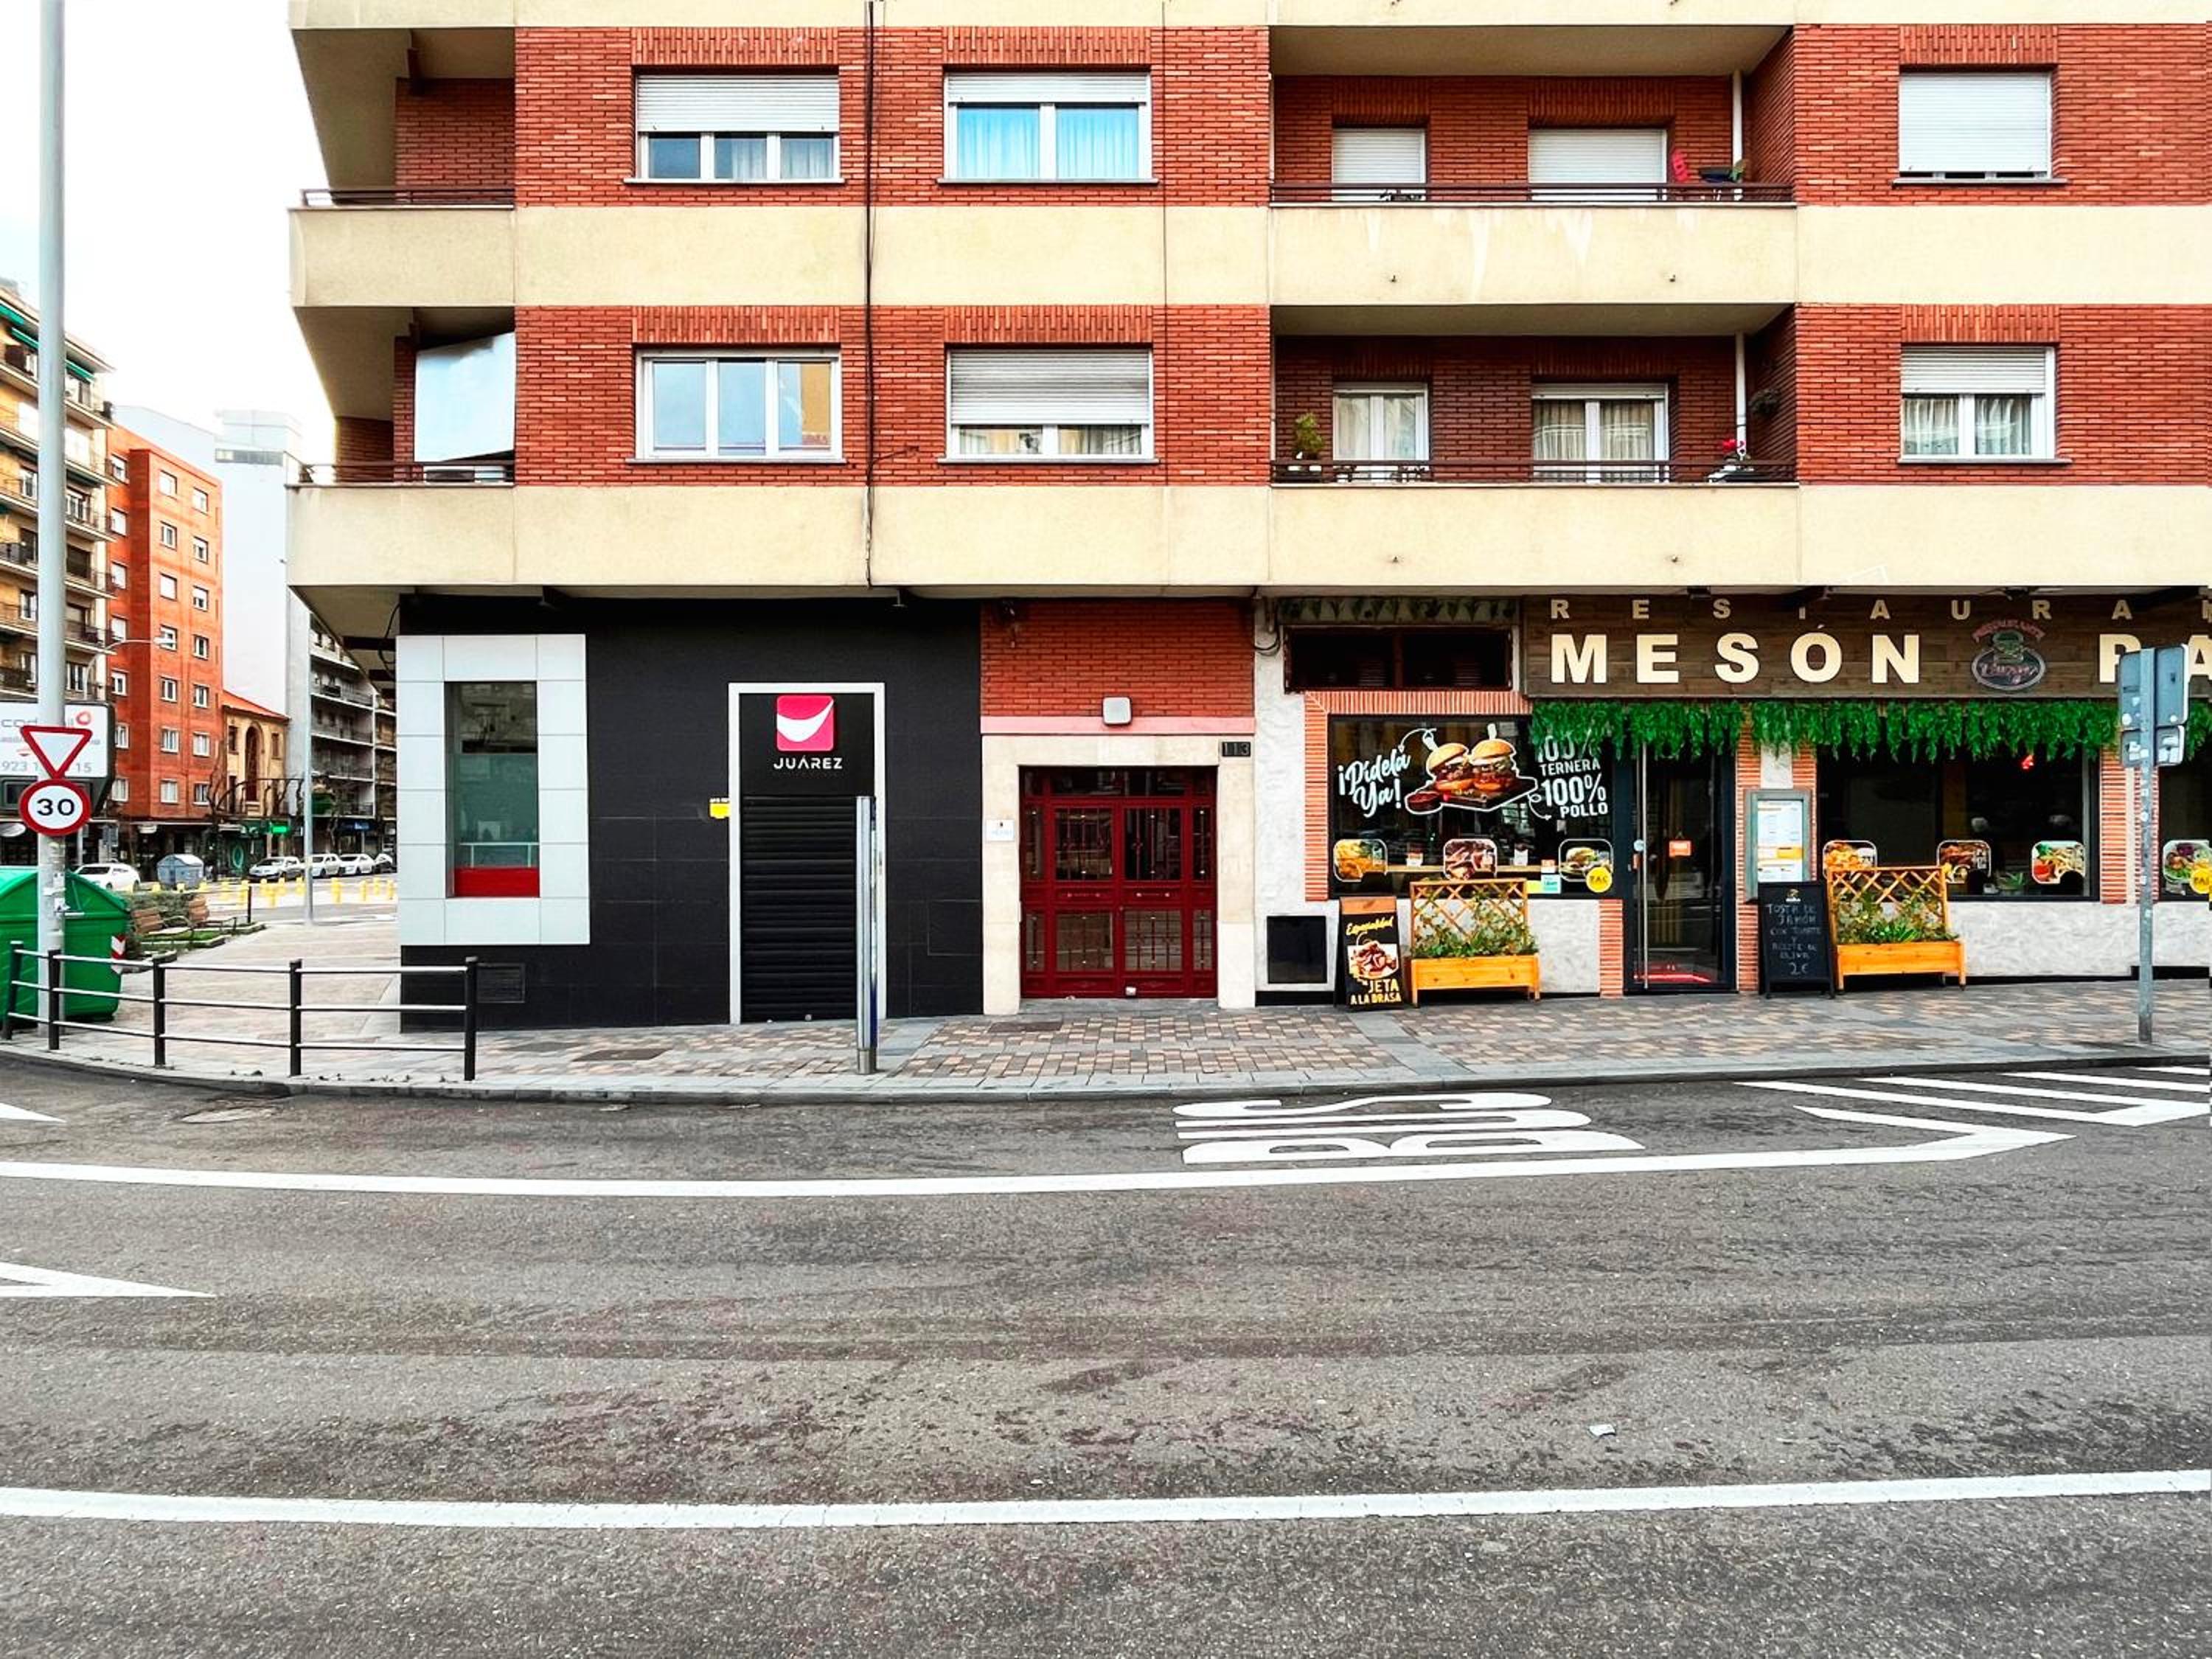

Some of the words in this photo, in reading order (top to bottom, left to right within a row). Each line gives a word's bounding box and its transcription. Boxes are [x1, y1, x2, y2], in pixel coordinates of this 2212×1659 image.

[1551, 624, 1920, 684] MESÓN
[1224, 742, 1250, 756] 113
[773, 754, 844, 770] JUÁREZ
[1539, 757, 1601, 777] TERNERA
[1352, 778, 1402, 818] Ya!
[1540, 772, 1607, 807] 100%
[36, 798, 75, 816] 30
[1559, 801, 1609, 819] POLLO
[1368, 978, 1399, 993] JETA
